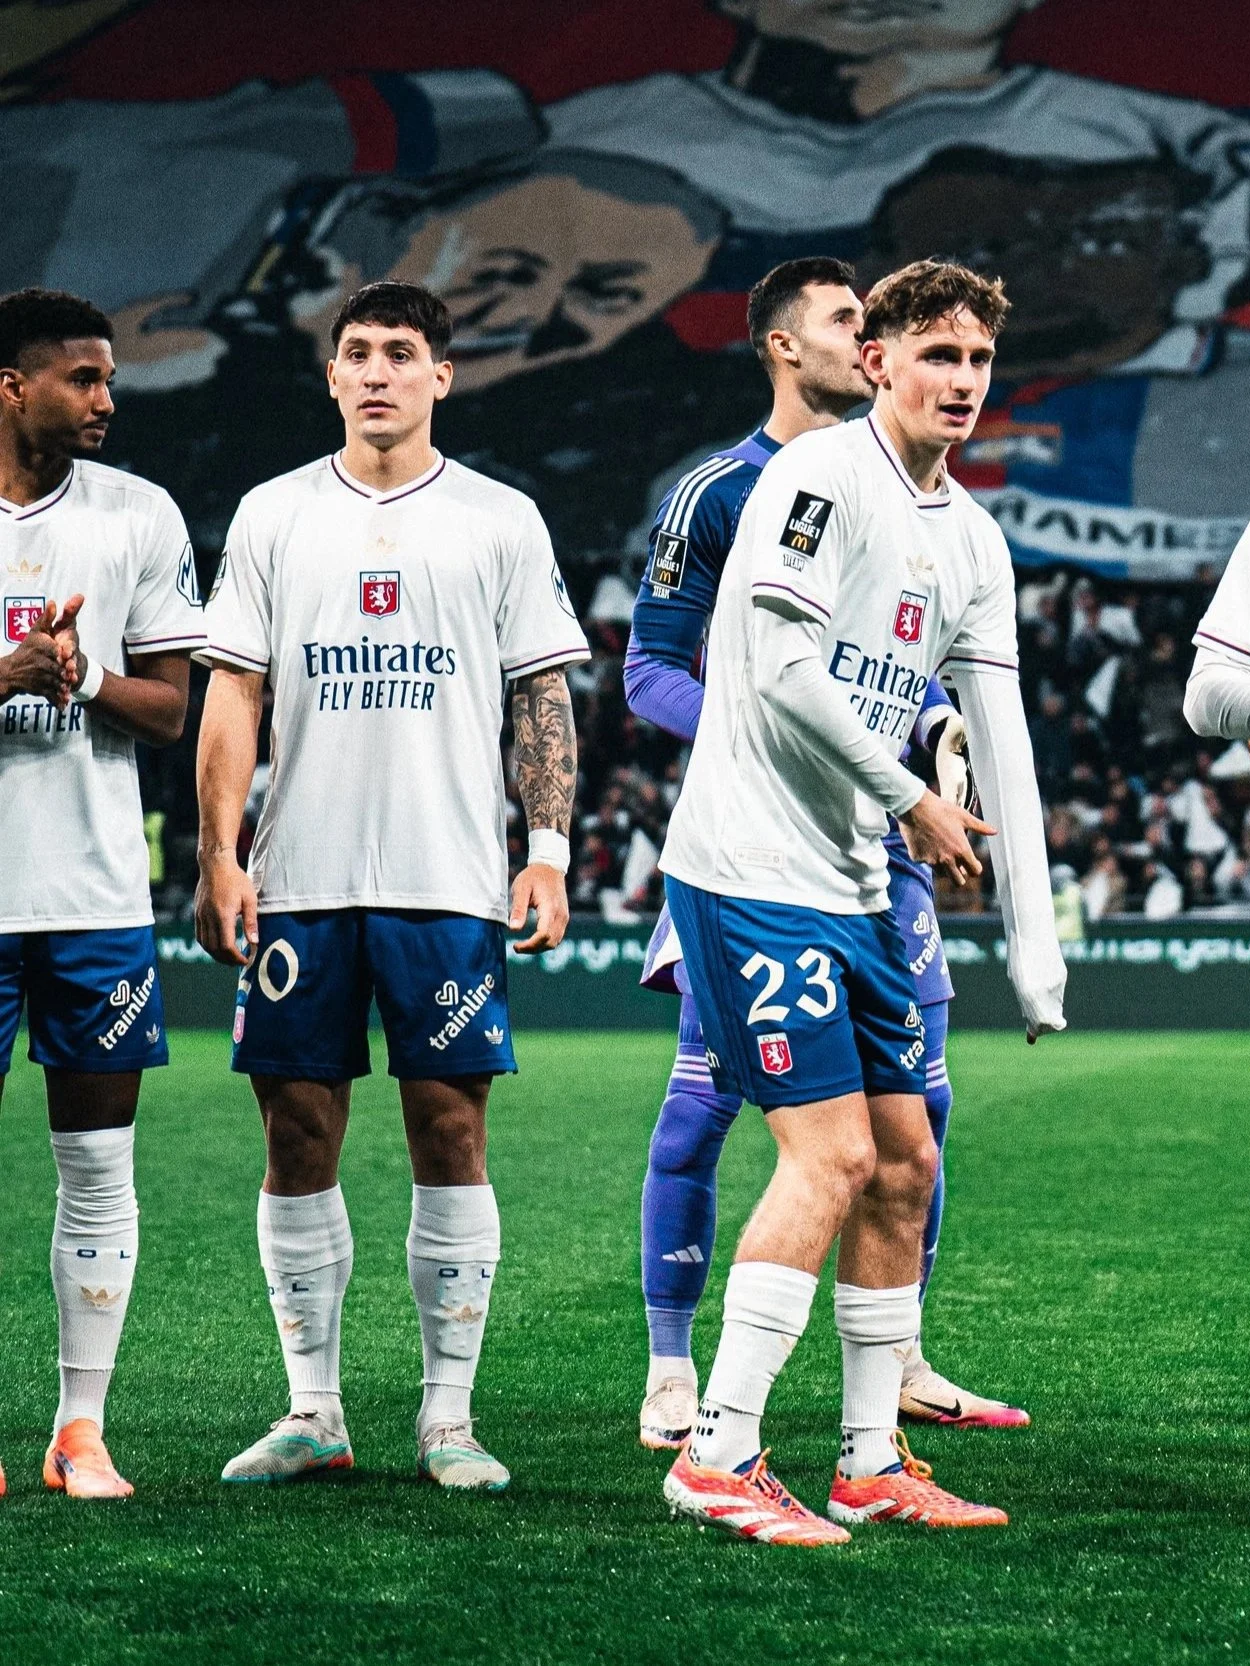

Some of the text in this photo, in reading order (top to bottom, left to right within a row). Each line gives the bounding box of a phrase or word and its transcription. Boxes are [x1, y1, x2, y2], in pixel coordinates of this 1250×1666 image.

[788, 518, 815, 538] LIGUE
[656, 557, 676, 572] LIGUE
[302, 636, 456, 679] Emirates
[828, 640, 928, 706] Eirae
[319, 680, 435, 711] FLY BETTER
[4, 702, 83, 735] BETTER
[98, 967, 154, 1050] trainline
[740, 948, 837, 1026] 23
[429, 973, 495, 1050] trainline
